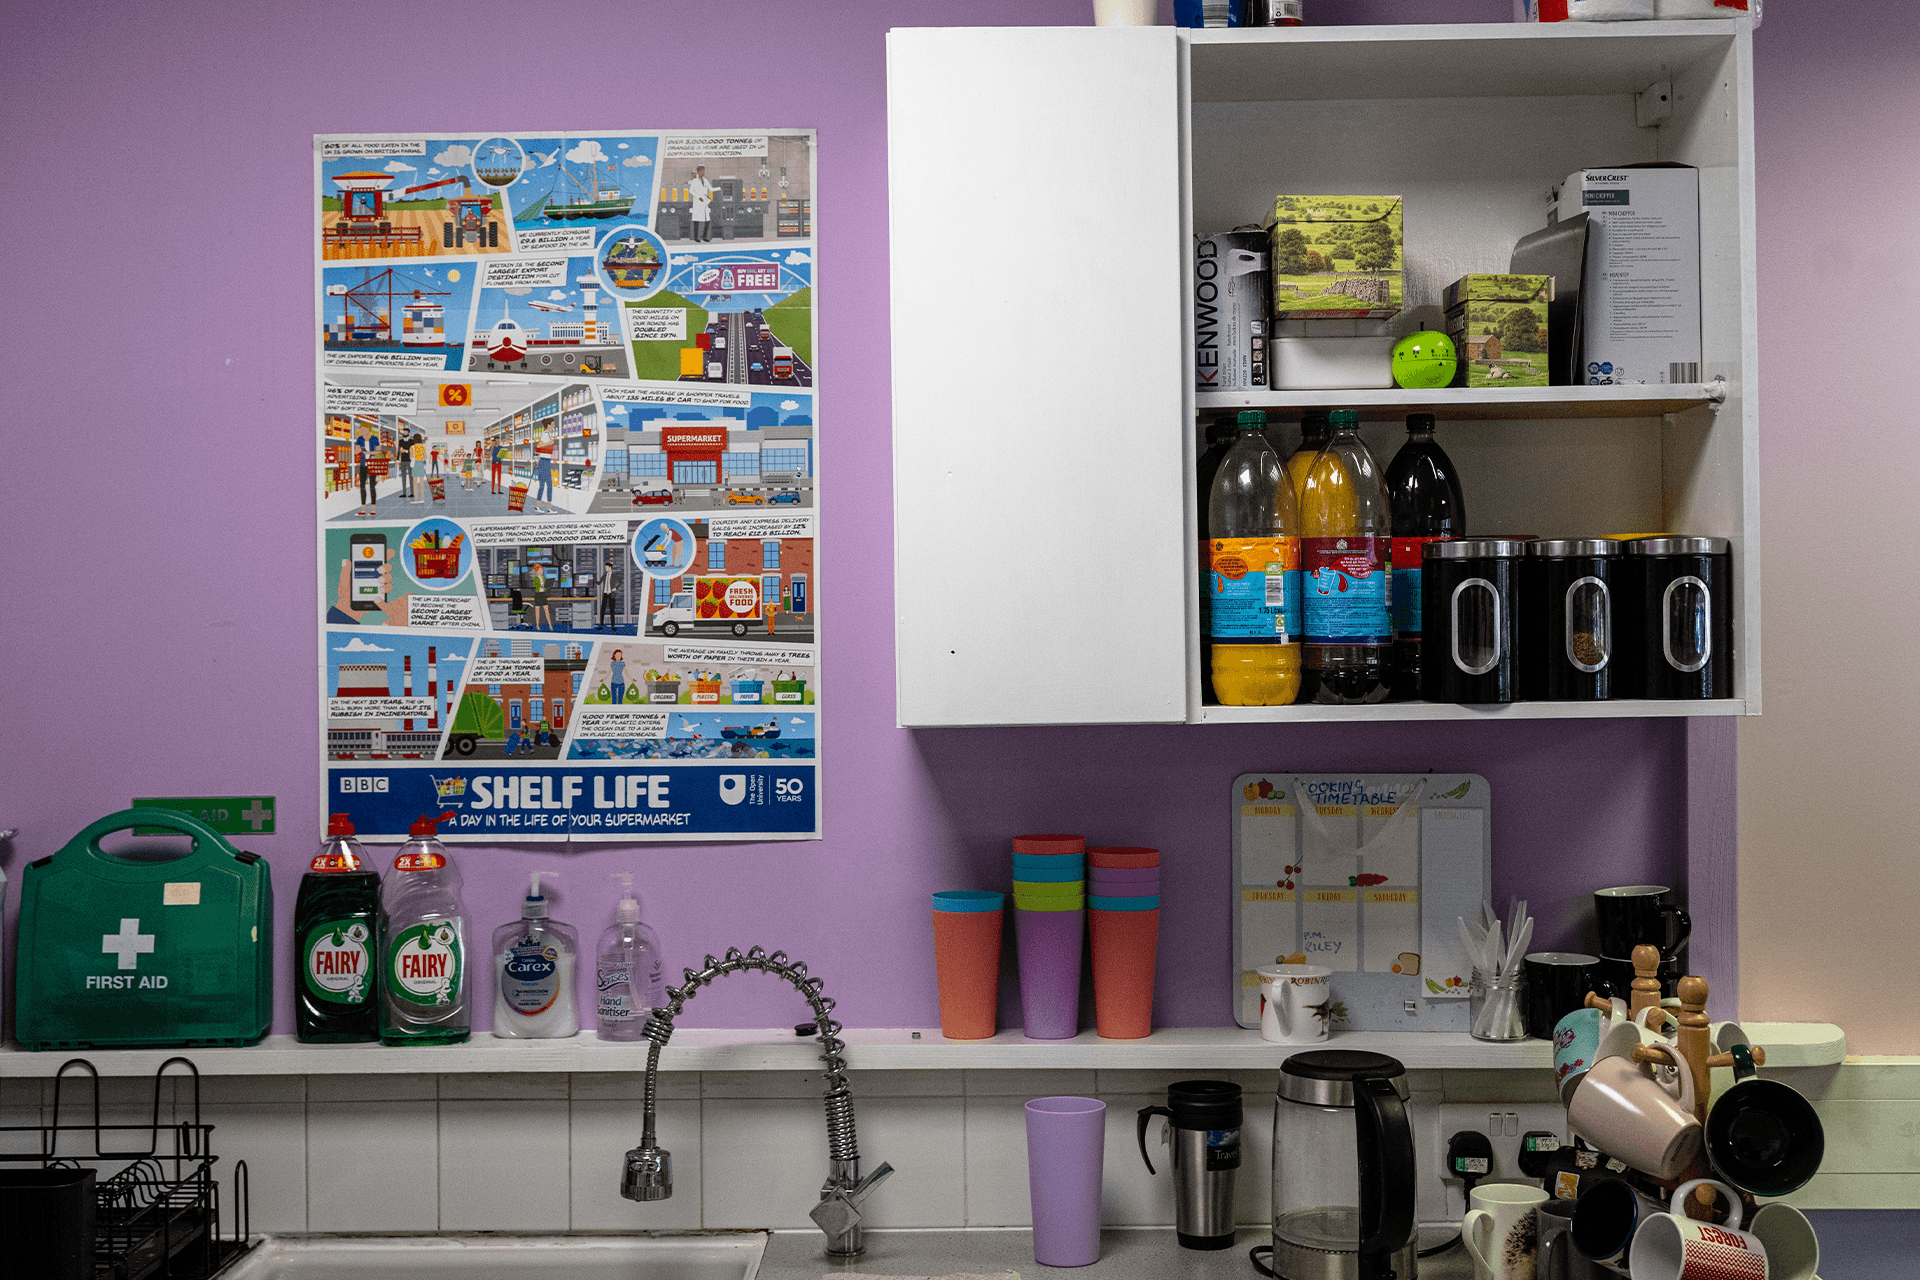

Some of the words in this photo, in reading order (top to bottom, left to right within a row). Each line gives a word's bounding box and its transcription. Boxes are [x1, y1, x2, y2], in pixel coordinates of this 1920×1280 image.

[738, 274, 775, 286] FREE!
[1196, 239, 1218, 387] KENWOOD
[341, 777, 389, 792] BBC
[775, 778, 803, 795] 50
[1301, 780, 1363, 794] OOKING
[471, 776, 583, 809] SHELF
[594, 775, 670, 808] LIFE
[1311, 792, 1396, 805] TIMETABLE
[449, 815, 457, 826] A
[461, 814, 483, 826] DAY
[486, 814, 496, 826] IN
[499, 814, 520, 826] THE
[524, 814, 548, 826] LIFE
[552, 814, 567, 826] OF
[571, 814, 602, 826] YOUR
[605, 813, 691, 826] SUPERMARKET
[315, 858, 326, 866] 2X
[399, 858, 411, 866] 2X
[1304, 942, 1342, 954] RILEY
[316, 951, 360, 974] FAIRY
[402, 953, 448, 978] FAIRY
[508, 962, 551, 972] Carex
[86, 976, 134, 989] FIRST
[139, 976, 168, 989] AID
[598, 969, 630, 987] Senses
[1291, 978, 1319, 987] ROBIN
[601, 996, 622, 1006] Hand
